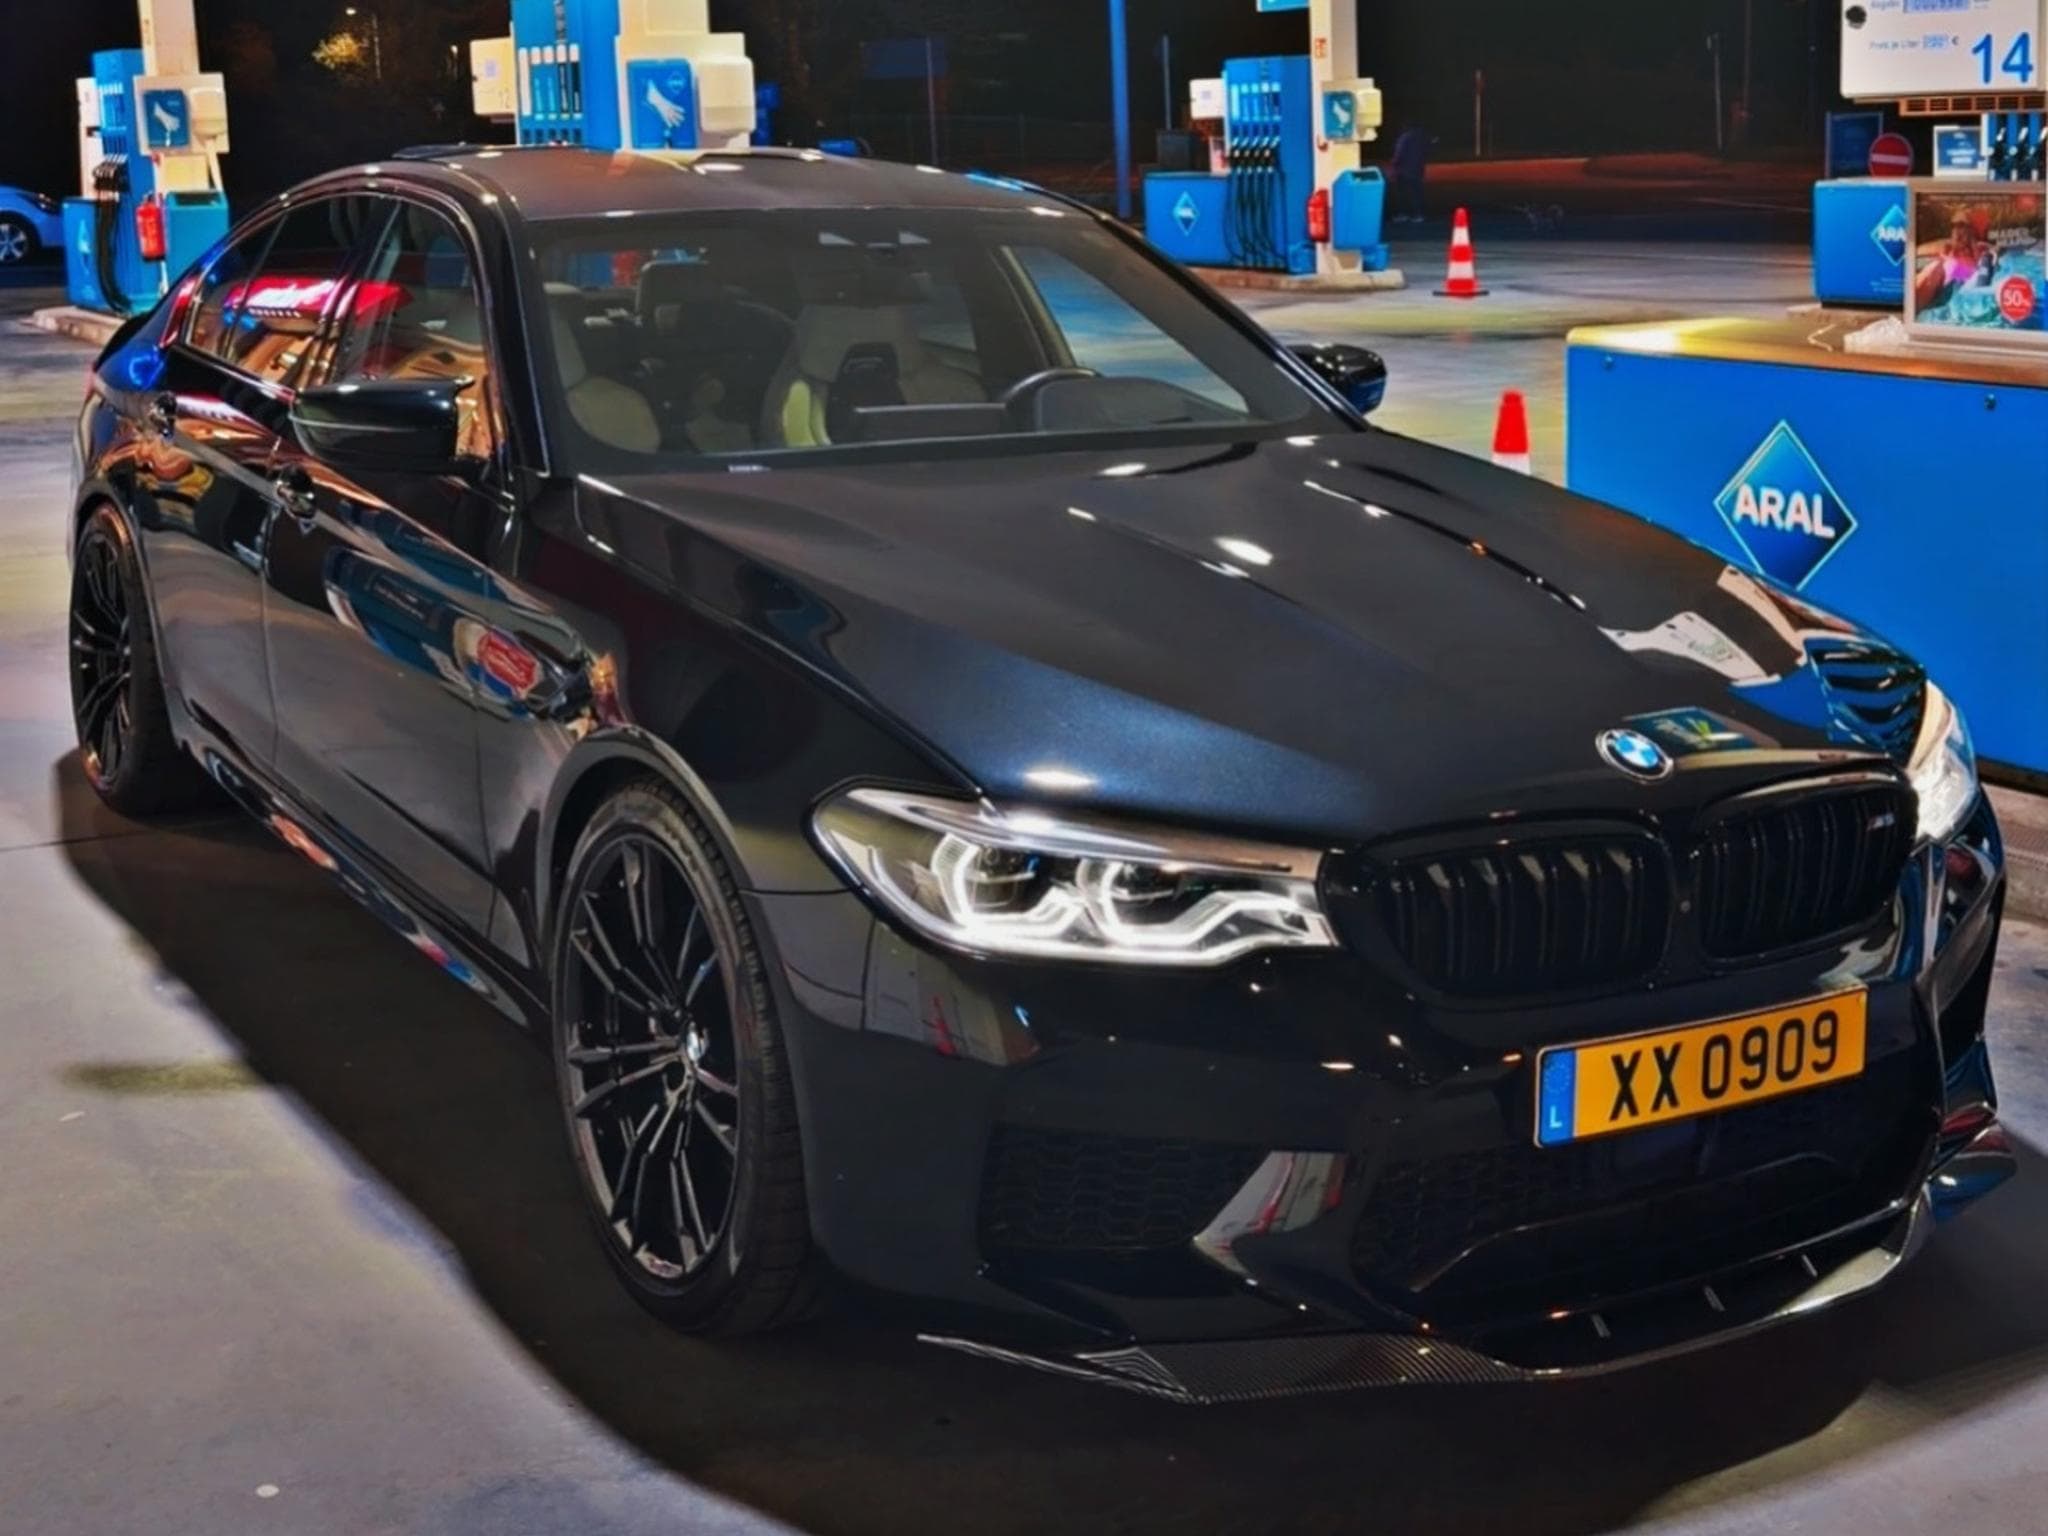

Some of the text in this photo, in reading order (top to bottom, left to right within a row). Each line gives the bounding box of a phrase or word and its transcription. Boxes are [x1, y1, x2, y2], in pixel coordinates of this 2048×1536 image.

[1972, 31, 2033, 84] 14
[1731, 482, 1836, 539] ARAL
[1608, 1009, 1839, 1122] XX 0909
[1550, 1105, 1563, 1128] L
